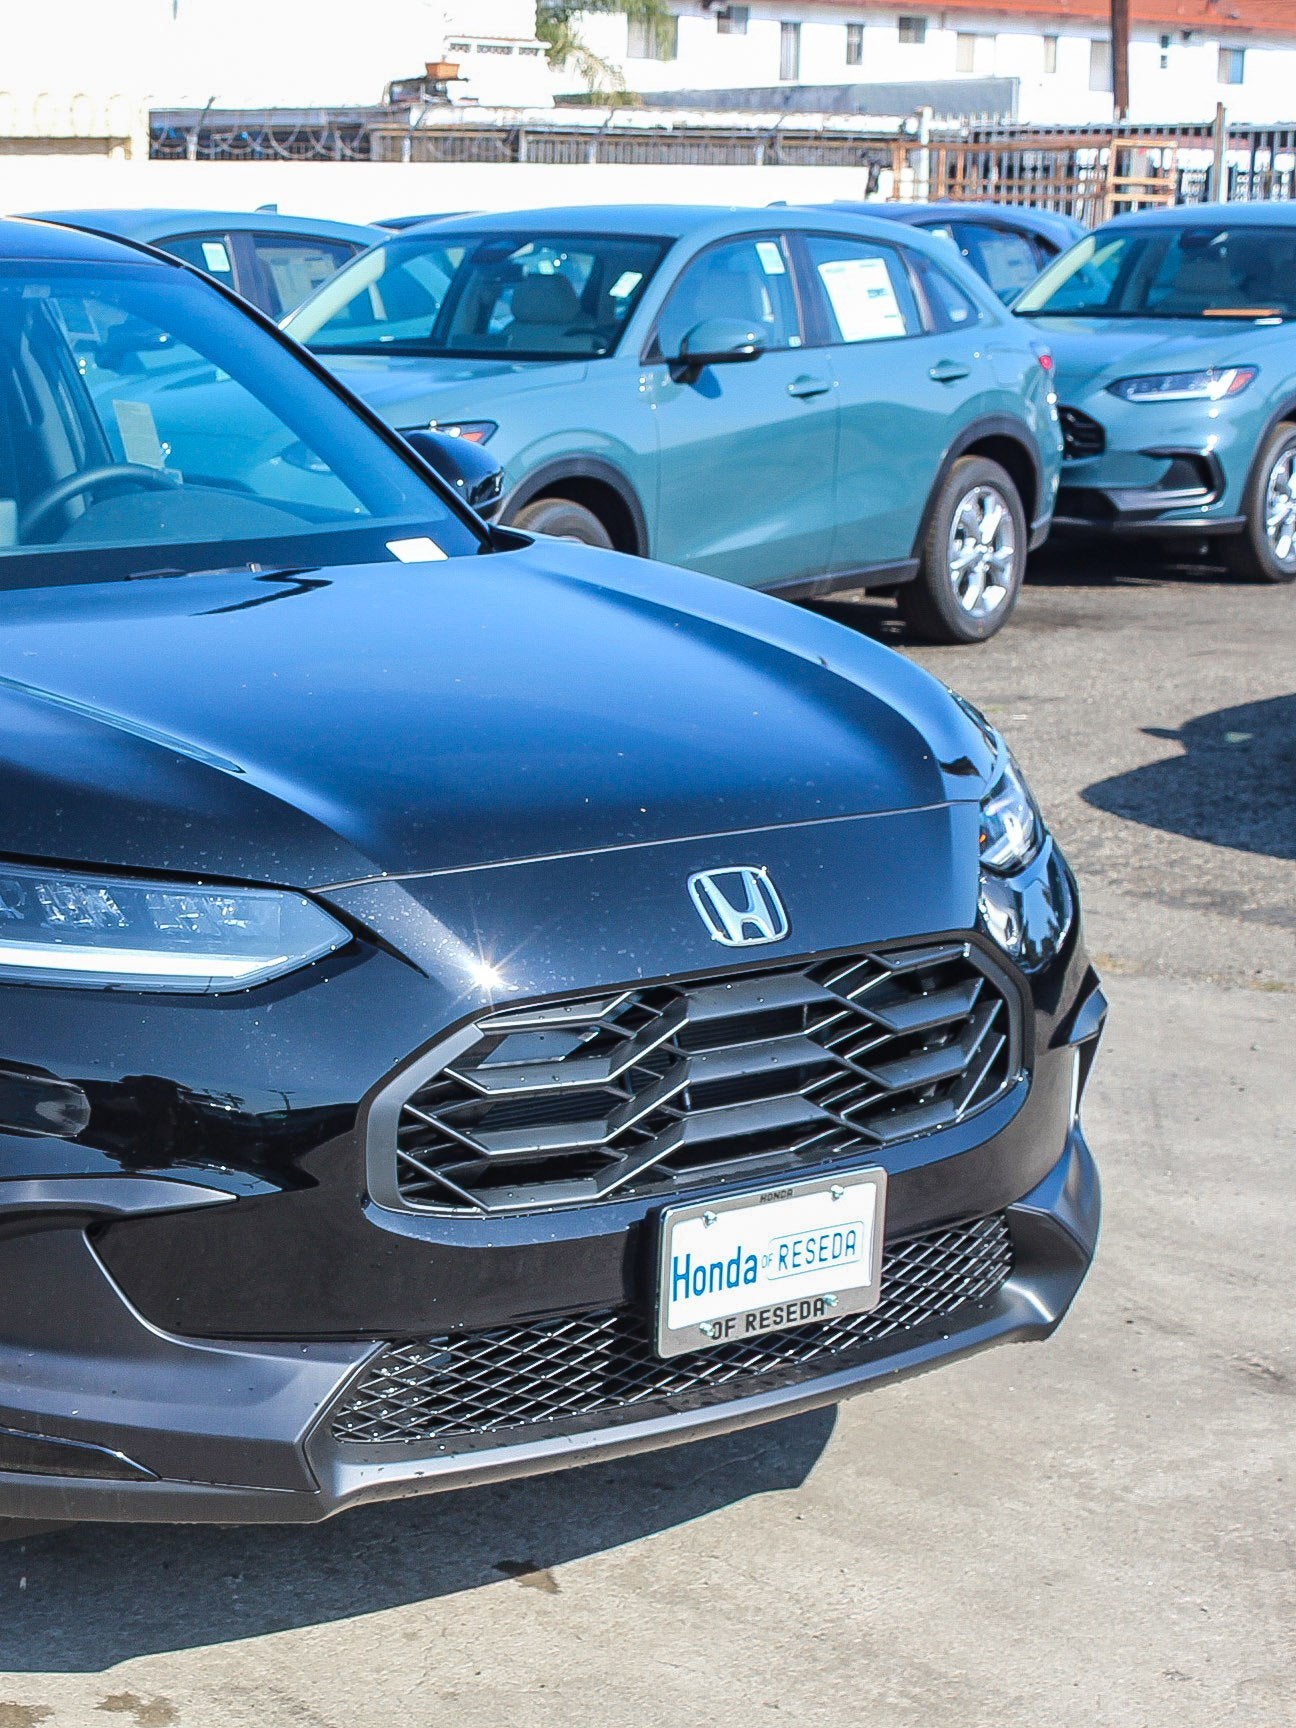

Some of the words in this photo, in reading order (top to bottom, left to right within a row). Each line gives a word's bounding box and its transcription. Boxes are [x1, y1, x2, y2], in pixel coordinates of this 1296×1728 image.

[759, 1188, 794, 1203] HONDA
[672, 1245, 758, 1302] Honda
[761, 1252, 774, 1269] OF
[778, 1229, 857, 1272] RESEDA
[711, 1317, 737, 1341] OF
[745, 1297, 825, 1333] RESEDA
